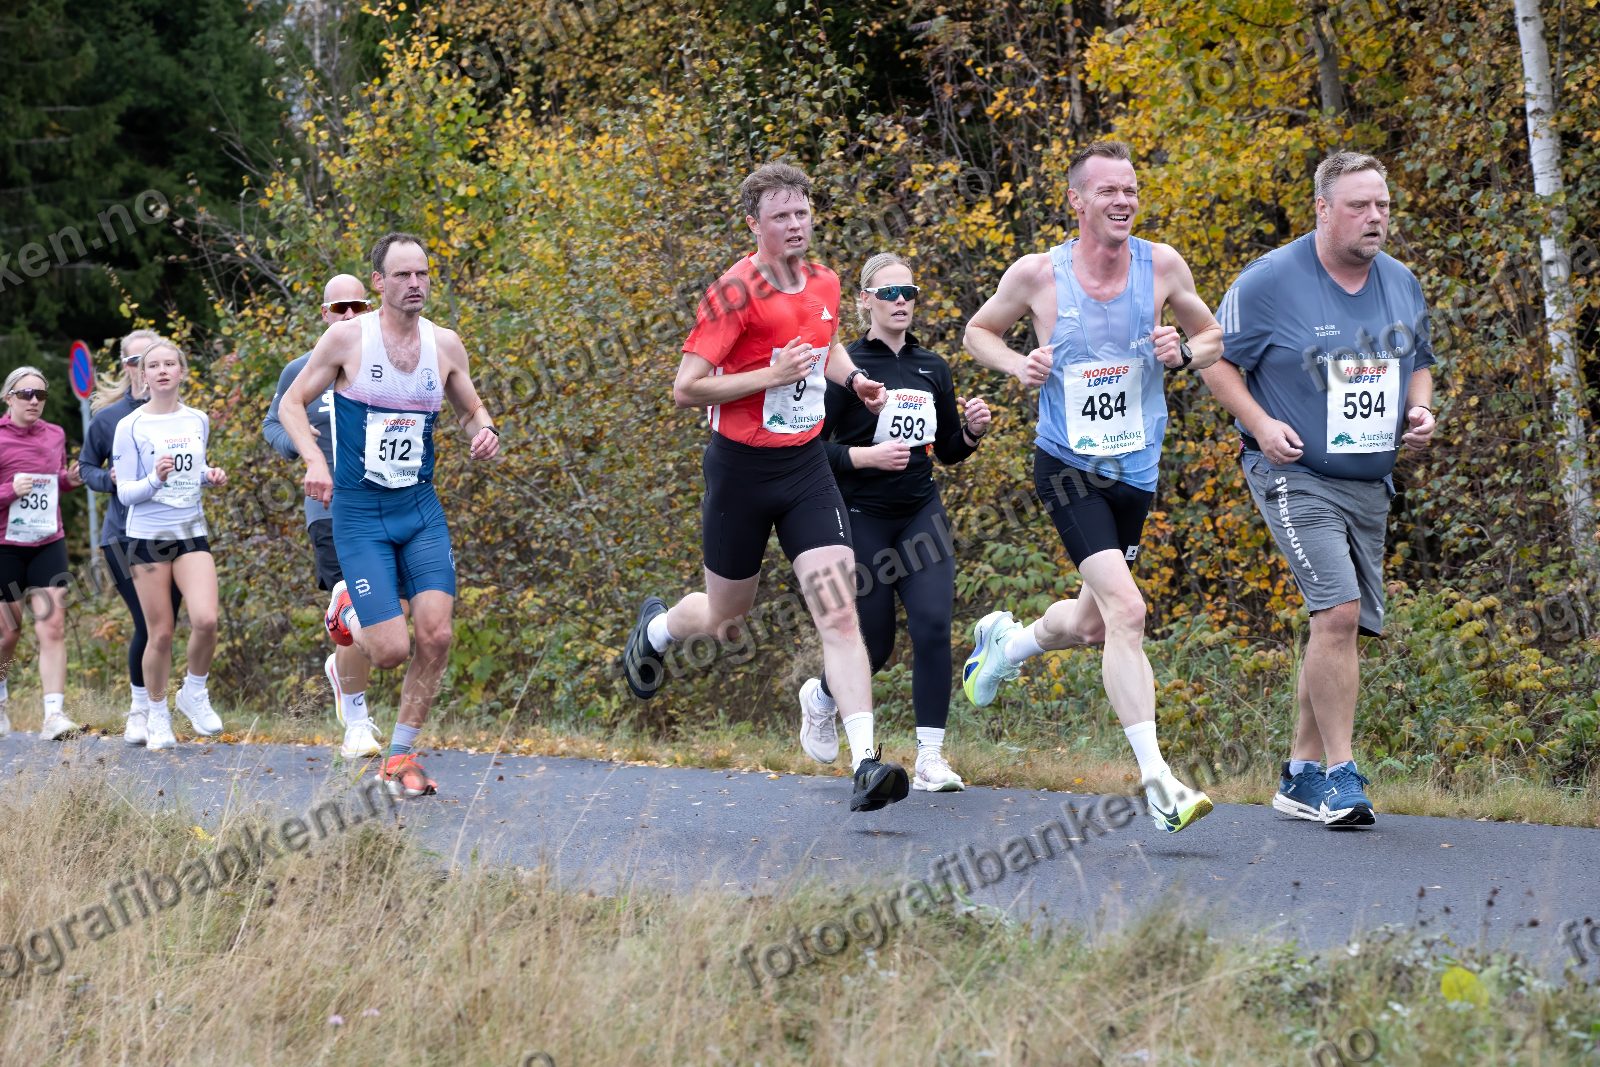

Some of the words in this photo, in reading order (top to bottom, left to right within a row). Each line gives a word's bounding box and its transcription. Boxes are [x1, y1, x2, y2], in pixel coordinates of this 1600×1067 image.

[1082, 366, 1130, 378] NORGES
[1344, 366, 1388, 375] NORGES
[1087, 374, 1122, 387] LØPET
[1348, 374, 1382, 384] LØPET
[793, 379, 806, 401] 9
[895, 393, 927, 404] NORGES
[1343, 390, 1386, 419] 594
[897, 402, 923, 411] LØPET
[1081, 391, 1127, 421] 484
[383, 418, 417, 427] NORGES
[889, 415, 926, 441] 593
[1102, 430, 1142, 444] Aurskog
[1359, 431, 1394, 442] Aurskog
[379, 438, 412, 461] 512
[174, 453, 193, 472] 03
[20, 493, 48, 510] 536
